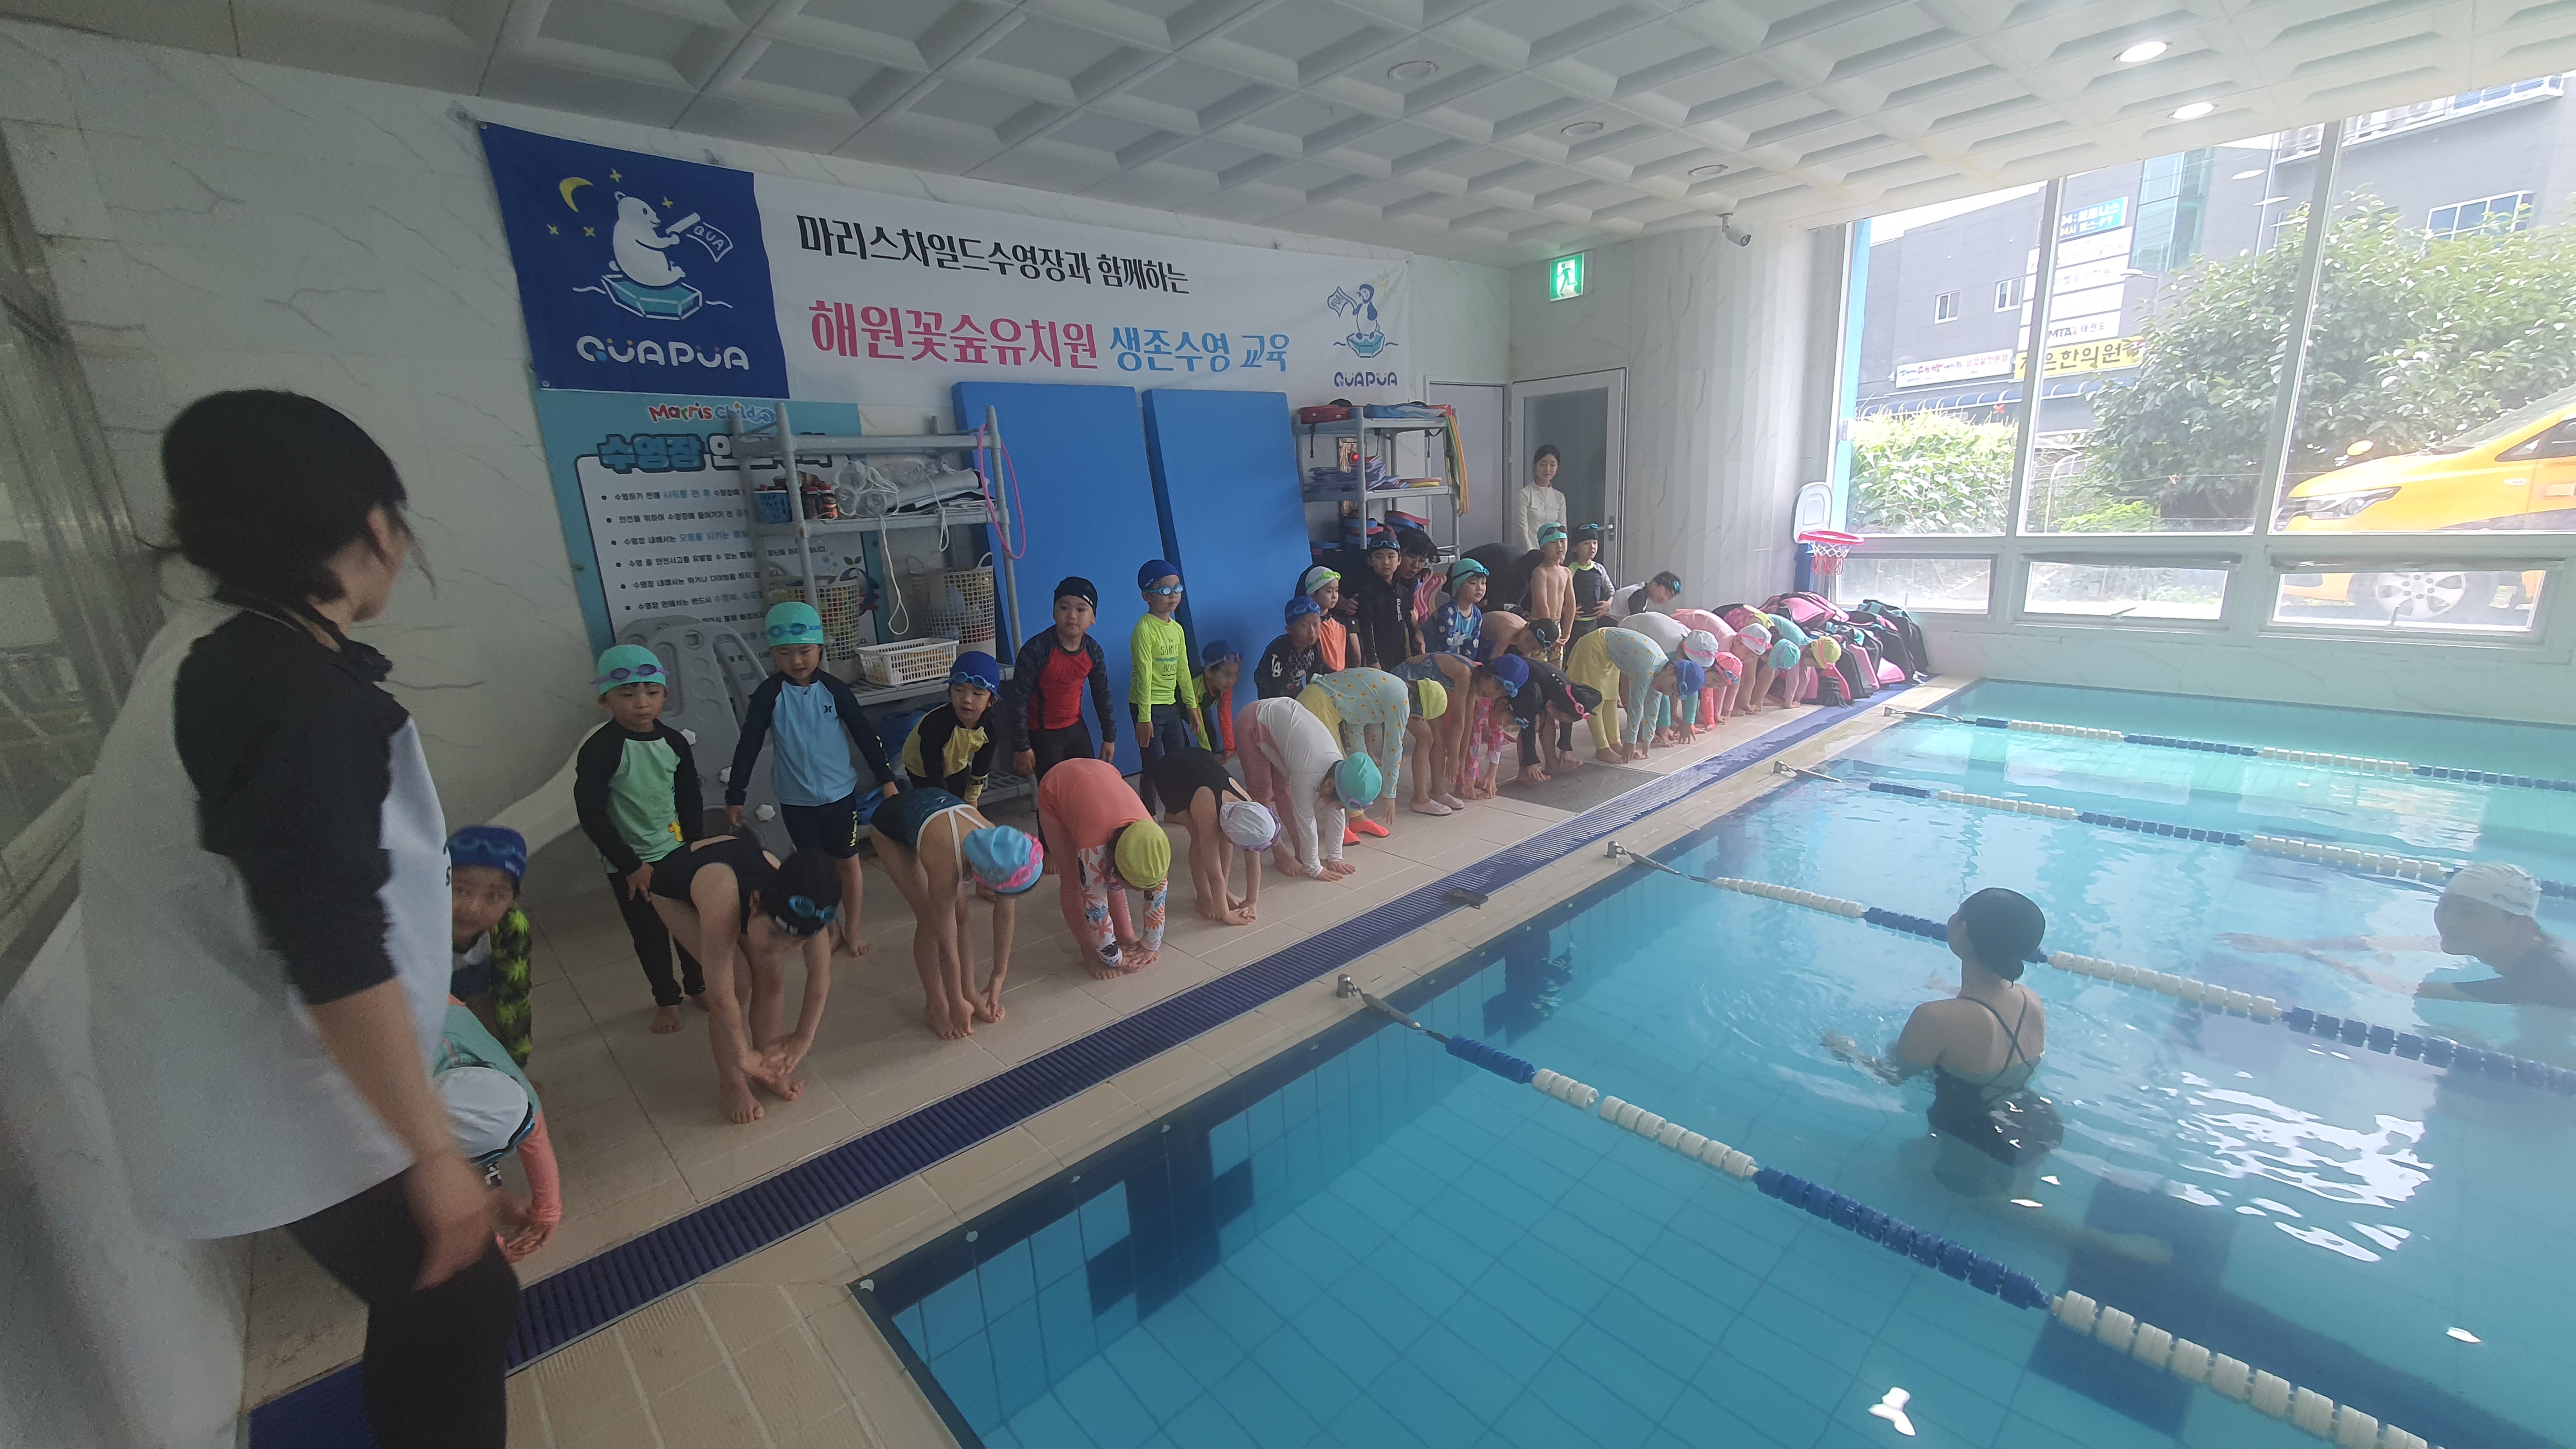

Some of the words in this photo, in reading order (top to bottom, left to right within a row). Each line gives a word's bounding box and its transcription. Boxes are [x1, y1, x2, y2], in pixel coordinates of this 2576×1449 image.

[694, 225, 724, 250] QUA
[797, 215, 1091, 284] 마리스차일드수영장과
[1096, 253, 1190, 294] 함께하는
[1330, 294, 1344, 310] PUA
[809, 300, 1098, 370] 해원꽃숲유치원
[1110, 326, 1230, 372] 생존수영
[1239, 333, 1290, 372] 교육
[2081, 322, 2105, 333] 태권도
[649, 402, 713, 422] Marris
[597, 434, 706, 473] 수영장
[1163, 664, 1177, 673] BEAC
